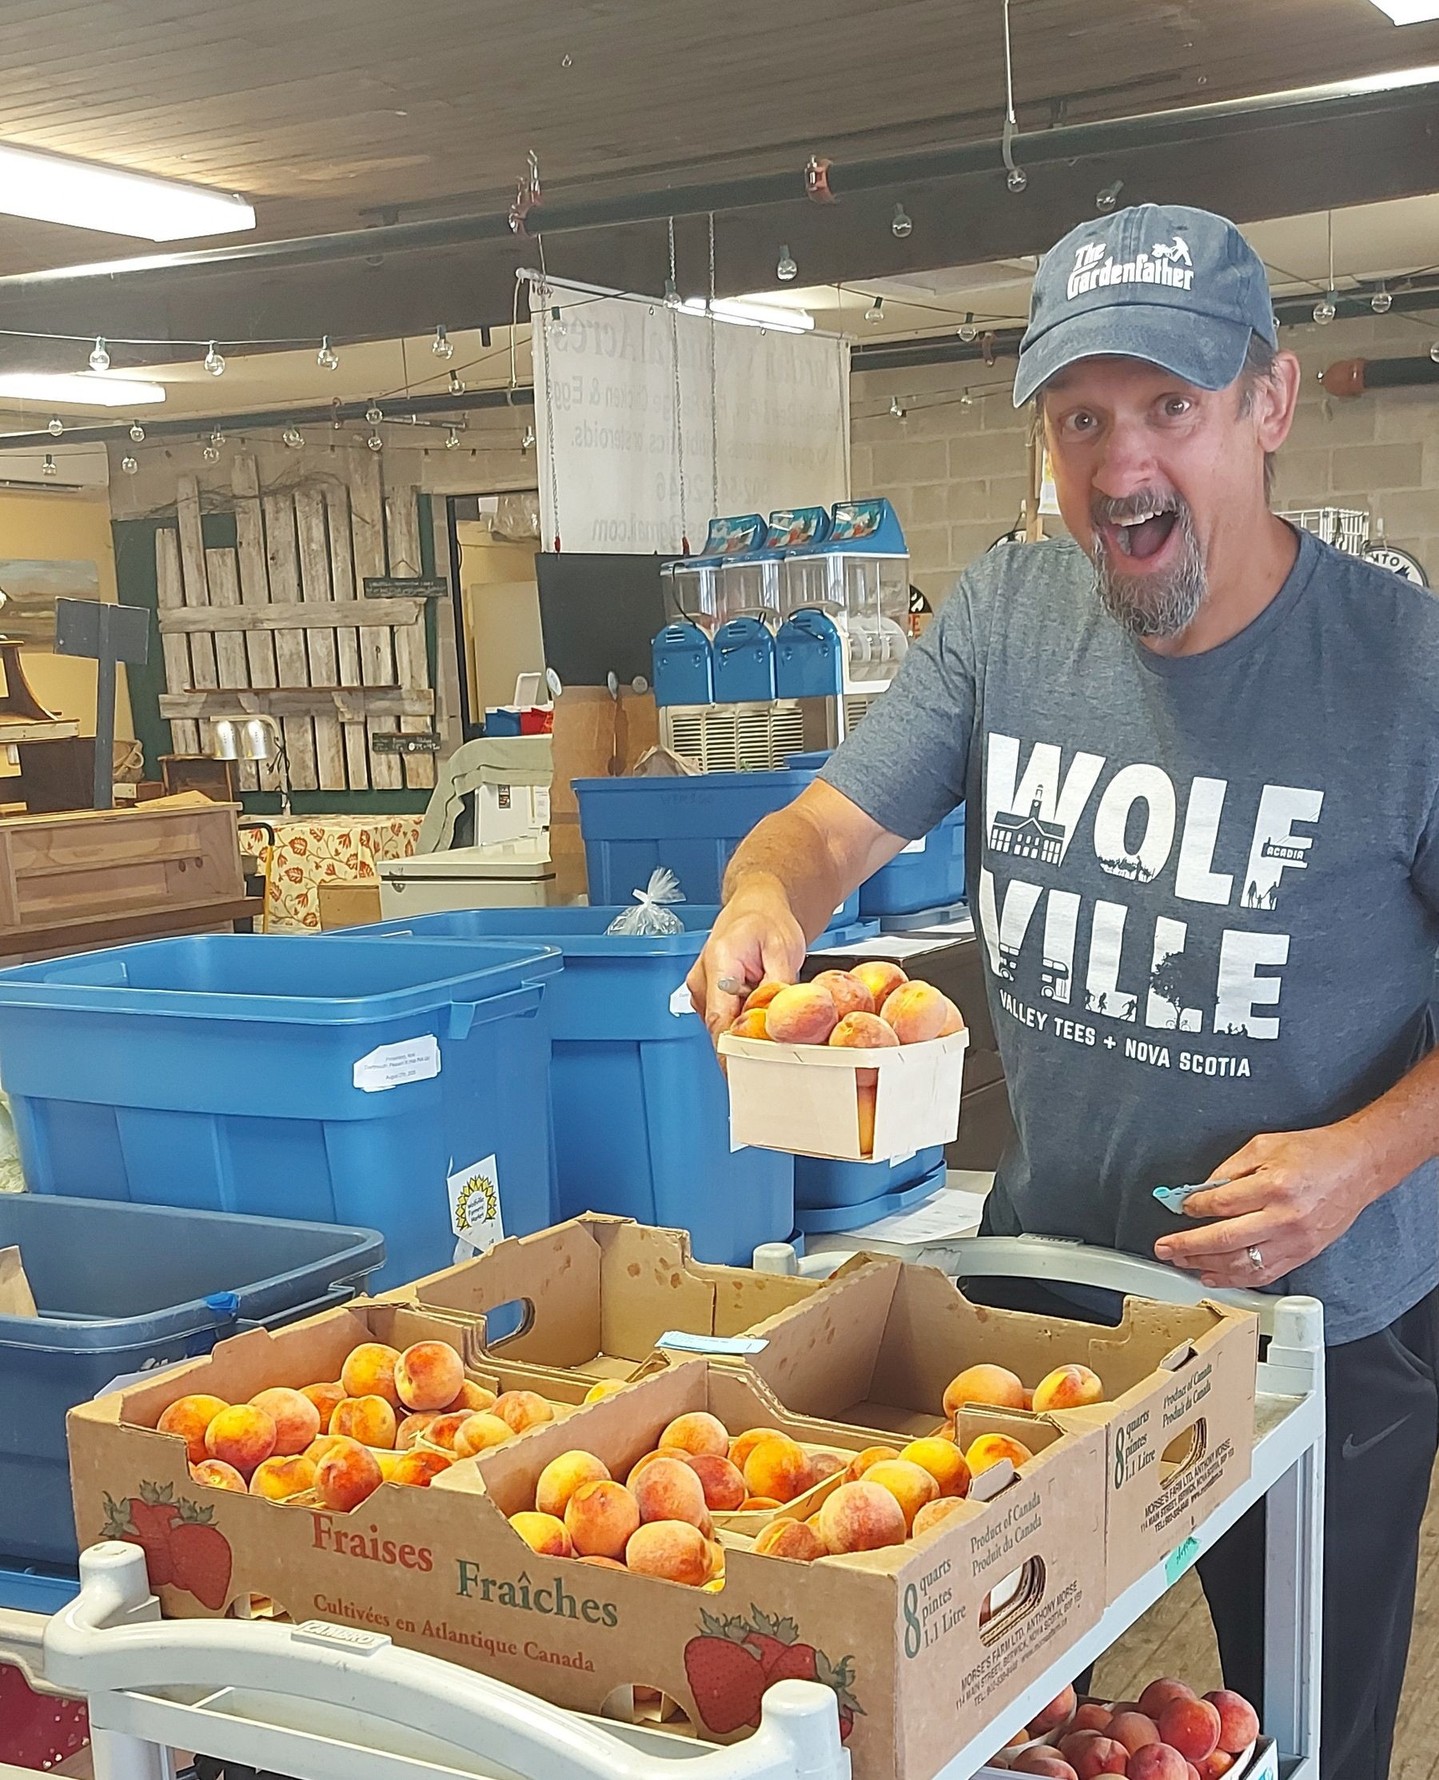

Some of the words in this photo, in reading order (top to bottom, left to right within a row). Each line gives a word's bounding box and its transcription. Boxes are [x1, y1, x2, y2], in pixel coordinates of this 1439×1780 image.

[1066, 253, 1194, 301] Gardenfather
[1073, 242, 1107, 272] The
[986, 732, 1324, 911] WOLF
[1266, 845, 1305, 860] ACADIA
[979, 865, 1291, 1040] VILLE
[1000, 989, 1046, 1032] VALLEY
[1053, 1016, 1097, 1047] TEES
[1125, 1037, 1171, 1068] NOVA
[1179, 1052, 1251, 1077] SCOTIA
[1126, 1409, 1150, 1439] quarts
[1115, 1427, 1124, 1489] 8
[1138, 1449, 1156, 1471] Litre
[310, 1511, 433, 1573] Fraises
[970, 1524, 1002, 1554] Product
[1003, 1508, 1013, 1529] of
[1013, 1491, 1041, 1522] Canada
[972, 1543, 1002, 1577] Produit
[1003, 1534, 1014, 1553] du
[1014, 1512, 1042, 1543] Canada
[456, 1558, 619, 1628] Fraîches
[920, 1559, 951, 1597] quarts
[922, 1587, 952, 1628] pintes
[313, 1594, 390, 1628] Cultivées
[396, 1617, 416, 1633] en
[421, 1619, 518, 1658] Atlantique
[523, 1641, 596, 1673] Canada
[903, 1583, 921, 1659] 8
[924, 1621, 939, 1648] 1.1
[942, 1605, 966, 1634] Litre
[991, 1644, 1011, 1664] FARM
[1026, 1602, 1056, 1634] ANTHONY
